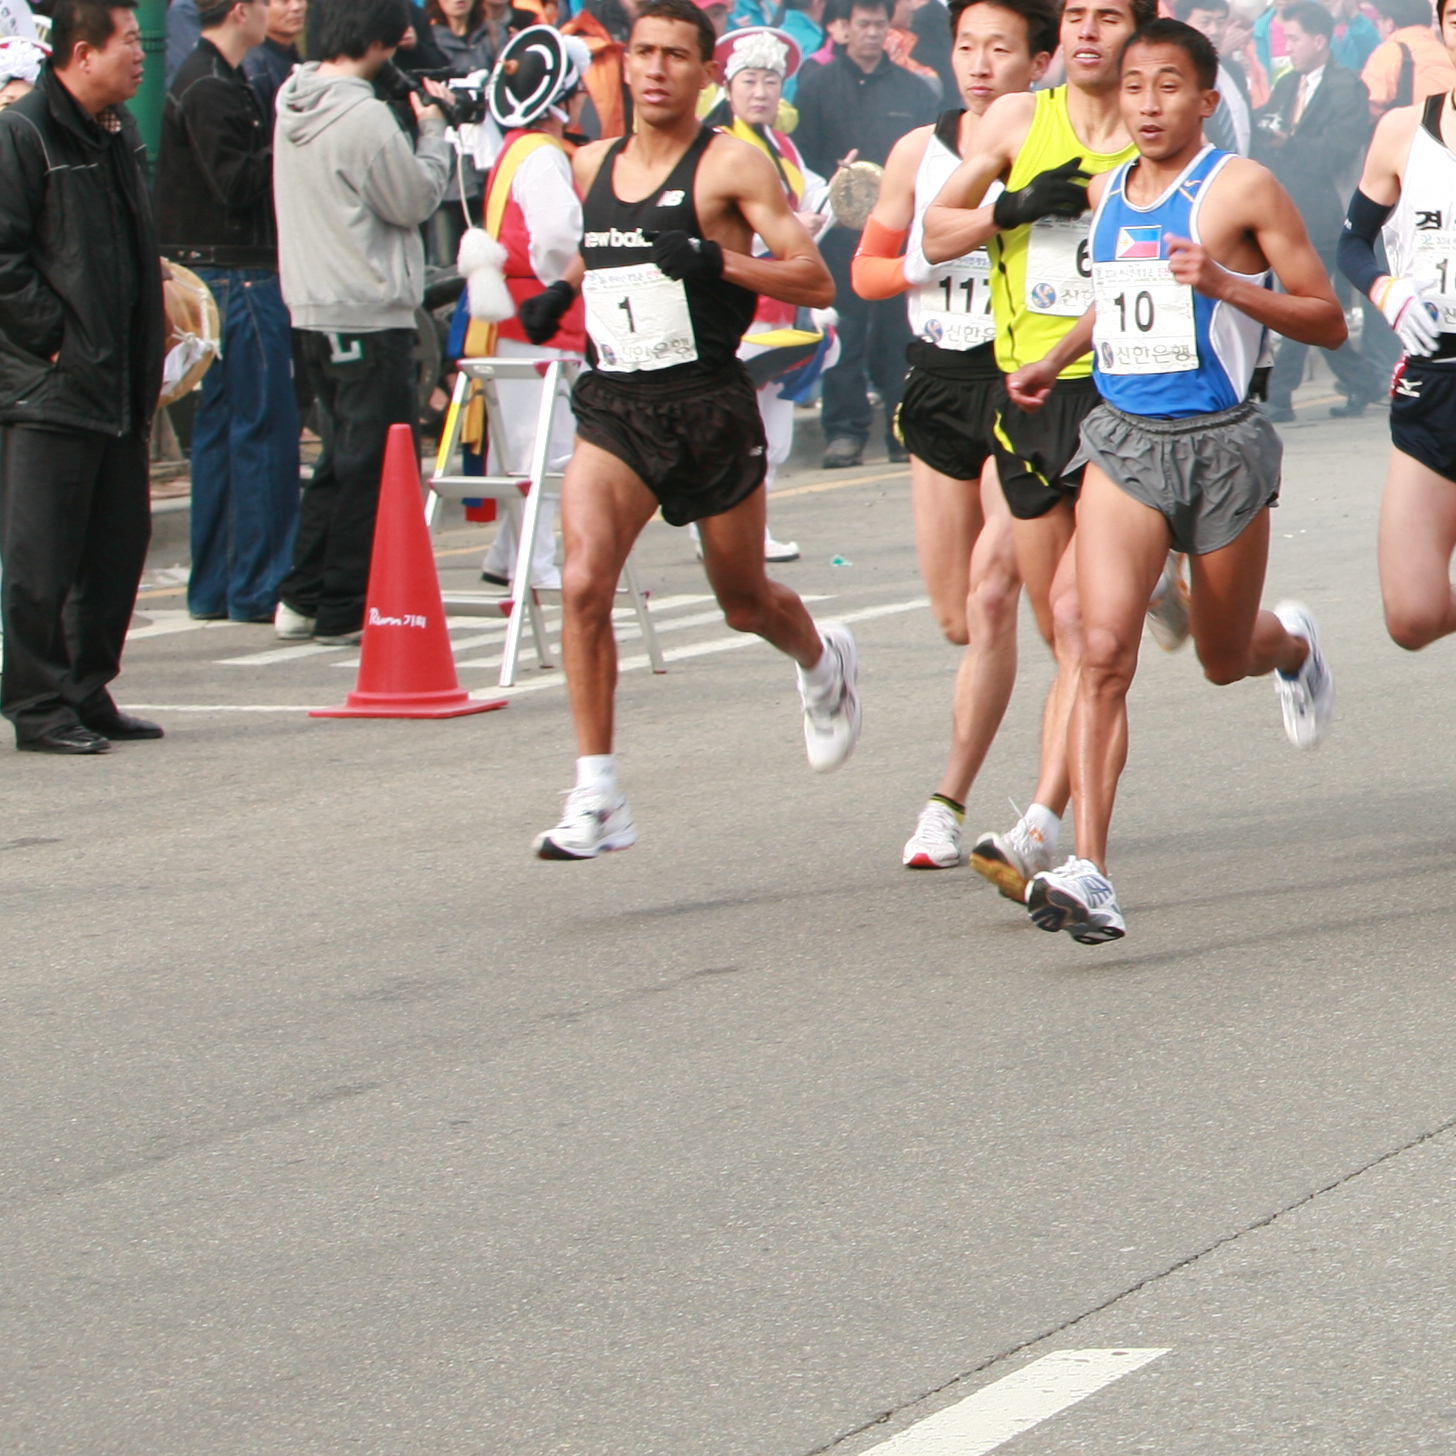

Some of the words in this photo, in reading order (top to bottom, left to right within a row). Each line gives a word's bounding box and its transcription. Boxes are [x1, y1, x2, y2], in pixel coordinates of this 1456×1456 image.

[618, 296, 637, 334] 1
[1114, 290, 1155, 333] 10
[1117, 344, 1191, 365] 신한은행
